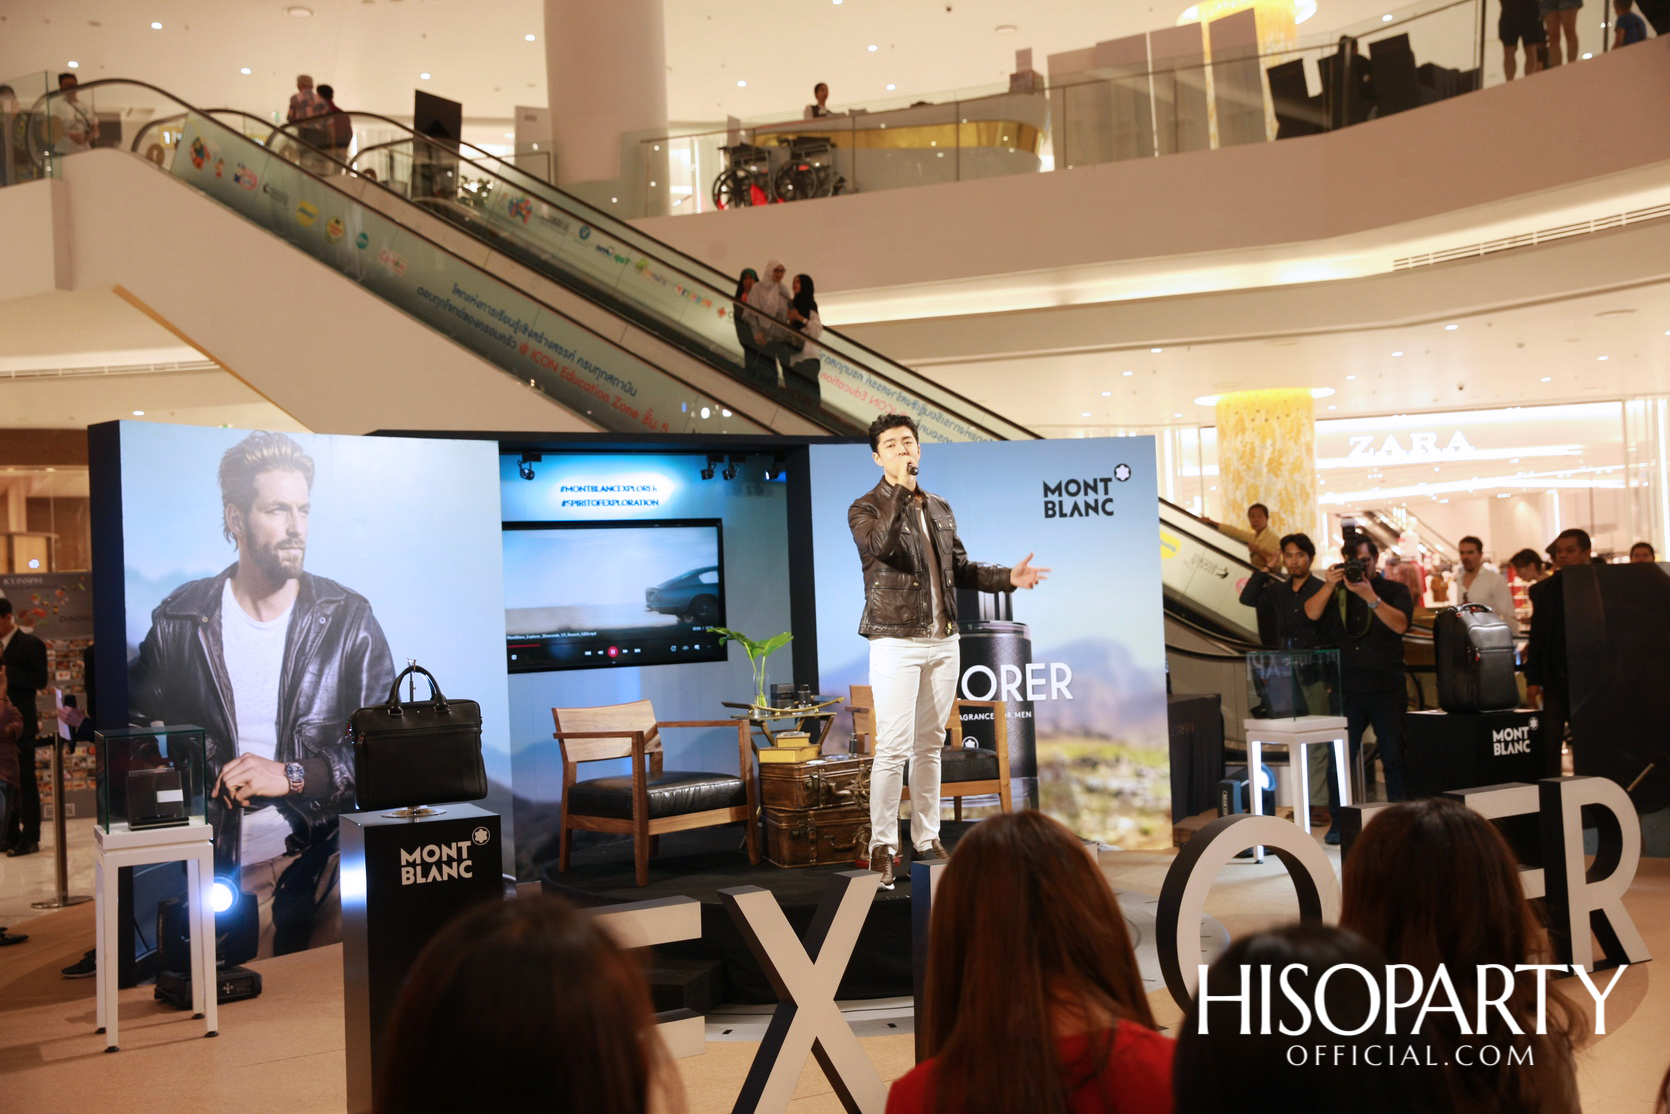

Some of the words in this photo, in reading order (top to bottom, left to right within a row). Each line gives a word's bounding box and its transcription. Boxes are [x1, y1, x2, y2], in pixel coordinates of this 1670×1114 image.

[530, 348, 559, 374] ICON
[560, 366, 611, 403] Education
[611, 395, 639, 419] Zone
[576, 356, 638, 398] ครบทุกสถาบัน
[1348, 429, 1476, 458] ZARA
[1043, 477, 1112, 498] MONT
[561, 499, 659, 507] #SPIRITOFEXPLORATION
[1044, 498, 1114, 518] BLANC
[957, 662, 1074, 703] ORER
[959, 712, 995, 721] AGRANCE
[1014, 711, 1032, 719] MEN
[1492, 726, 1529, 742] MONT
[1493, 740, 1531, 756] BLANC
[400, 841, 472, 866] MONT
[401, 860, 473, 886] BLANC
